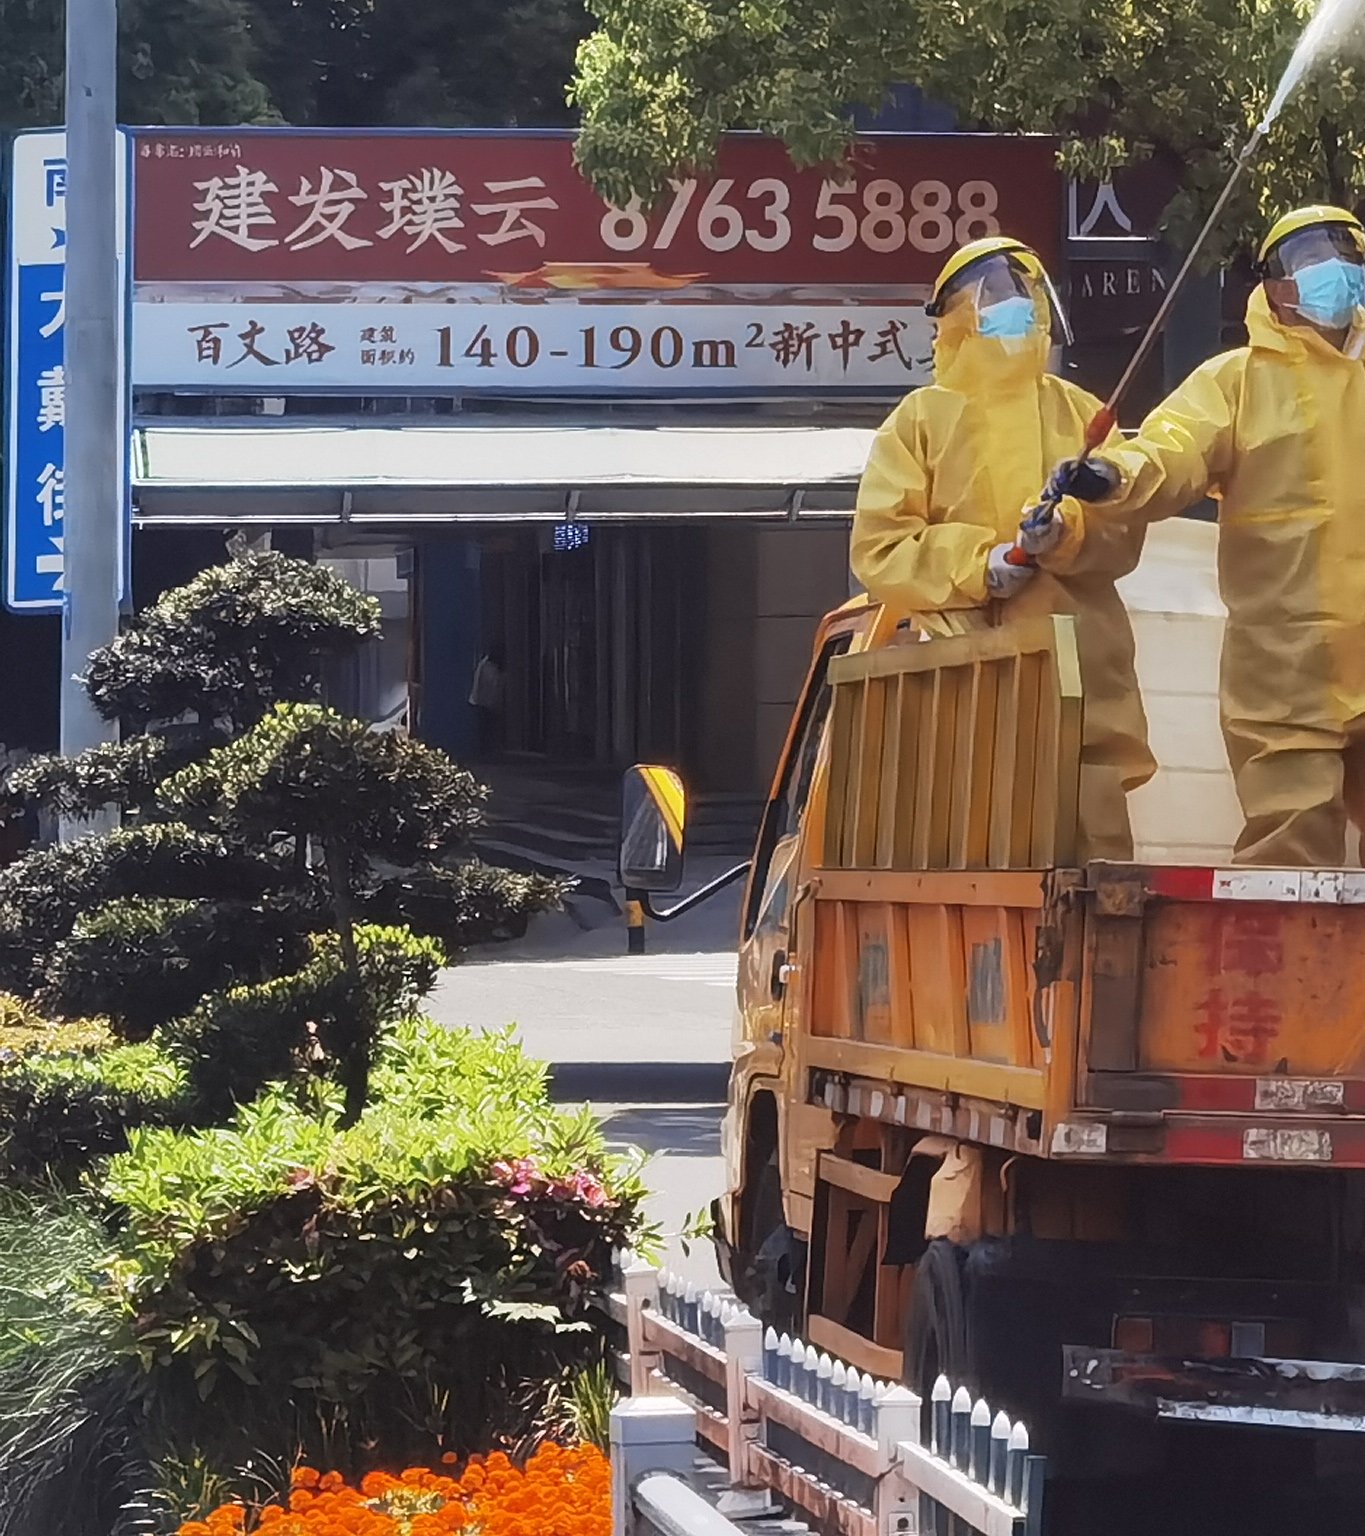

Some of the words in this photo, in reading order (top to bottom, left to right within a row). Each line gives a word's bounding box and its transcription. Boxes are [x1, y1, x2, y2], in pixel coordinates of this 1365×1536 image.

[189, 164, 560, 255] 建发璞云
[600, 177, 792, 253] 8763
[812, 178, 1001, 253] 5888
